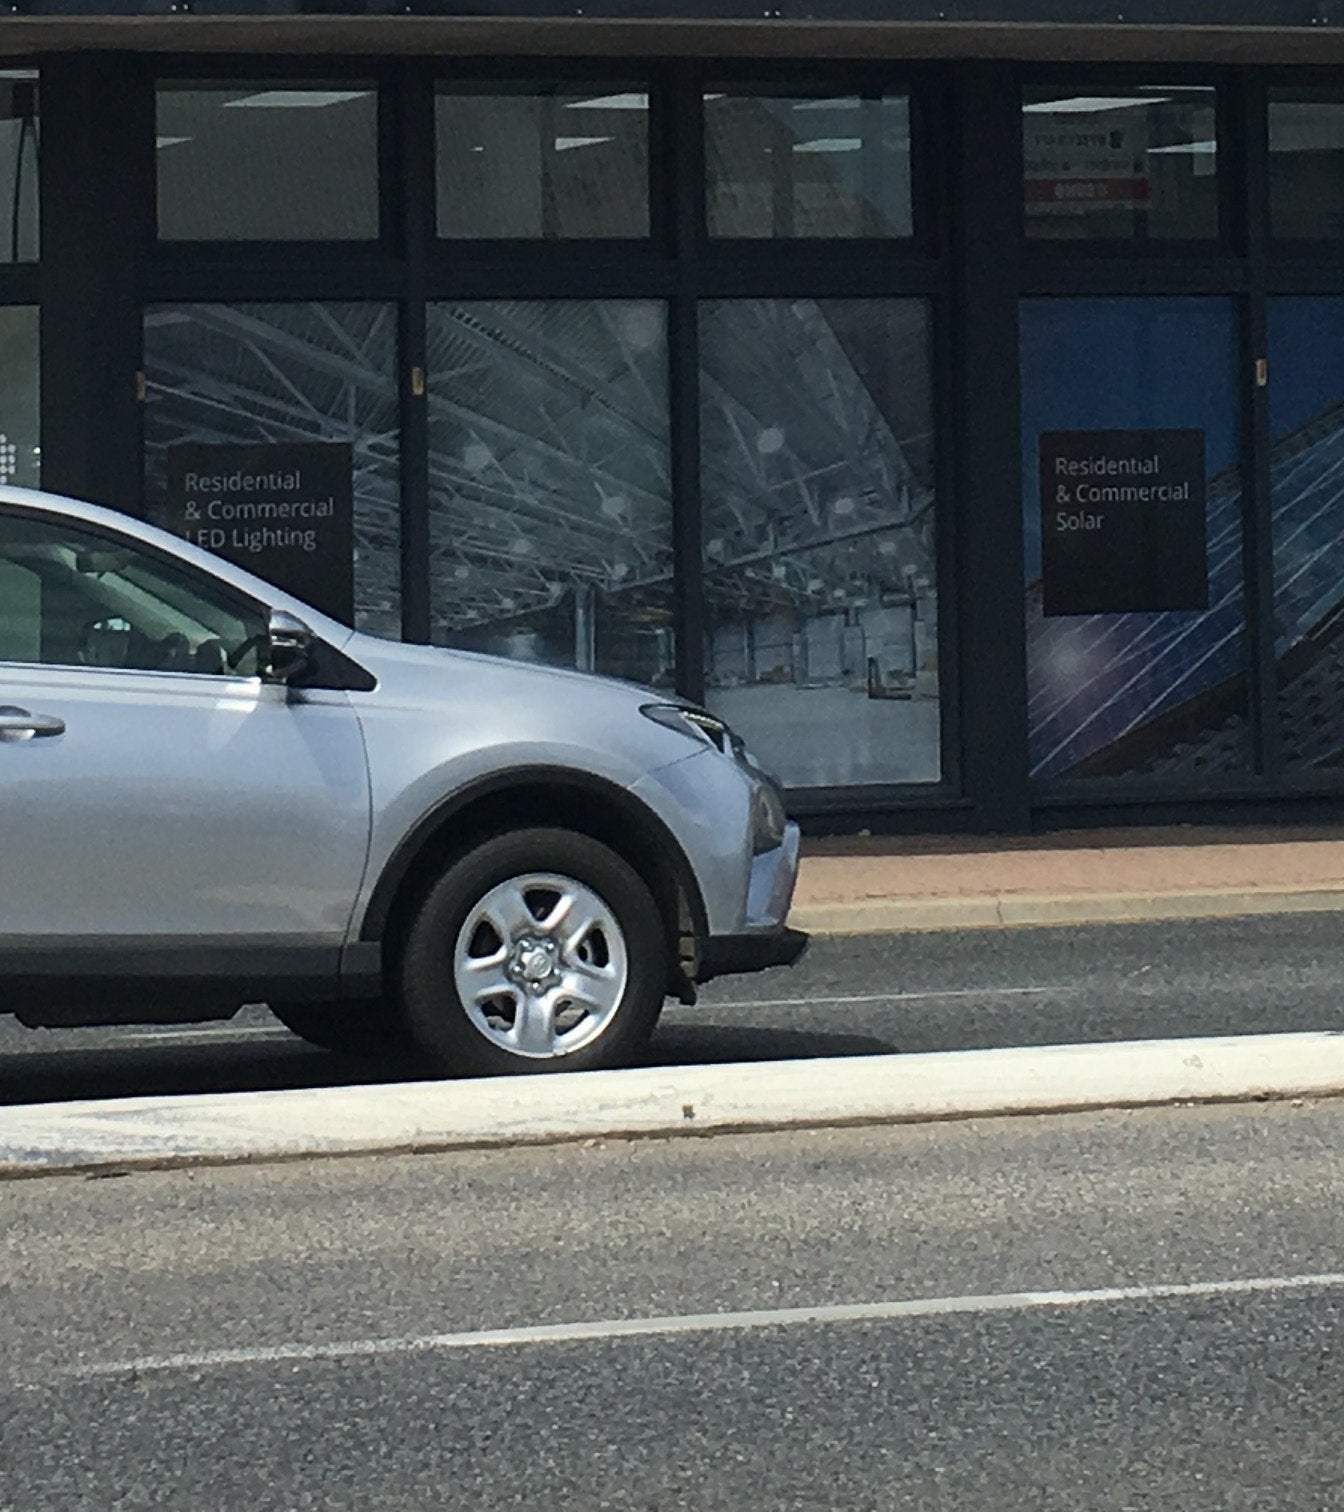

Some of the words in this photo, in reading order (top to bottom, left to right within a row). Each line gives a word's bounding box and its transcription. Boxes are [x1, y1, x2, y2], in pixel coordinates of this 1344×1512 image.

[1056, 454, 1159, 475] Residential
[184, 470, 301, 492] Residential
[1056, 485, 1071, 503] &
[1076, 482, 1189, 502] Commercial
[184, 500, 201, 520] &
[208, 497, 334, 519] Commercial
[1056, 511, 1104, 531] Solar
[232, 527, 316, 552] Lighting
